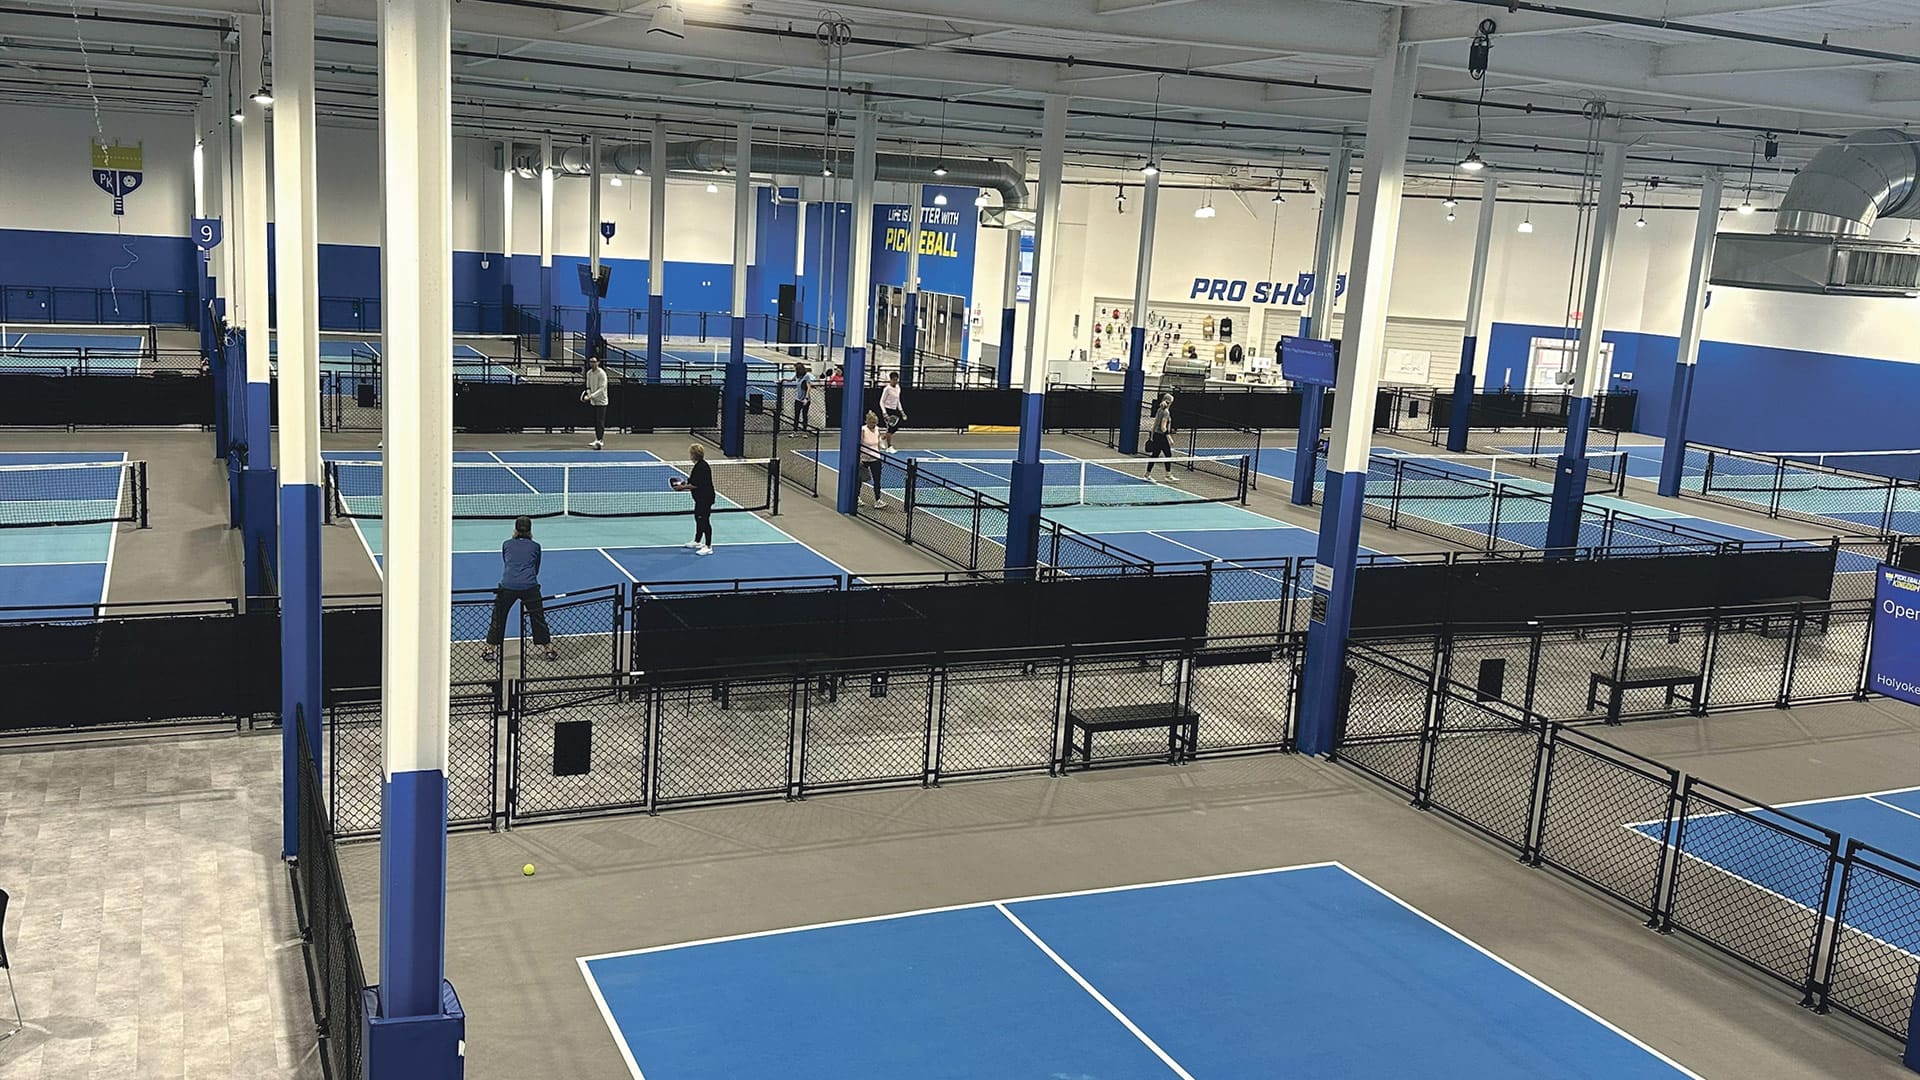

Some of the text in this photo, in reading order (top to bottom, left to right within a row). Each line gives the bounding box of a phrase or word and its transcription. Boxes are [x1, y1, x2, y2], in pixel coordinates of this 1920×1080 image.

[909, 207, 942, 224] TTER
[942, 211, 961, 225] WITH
[200, 225, 213, 242] 9
[886, 228, 958, 257] PICKEBALL
[1190, 278, 1248, 303] PRO
[1305, 277, 1312, 291] 7
[1877, 673, 1920, 695] Holyoke
